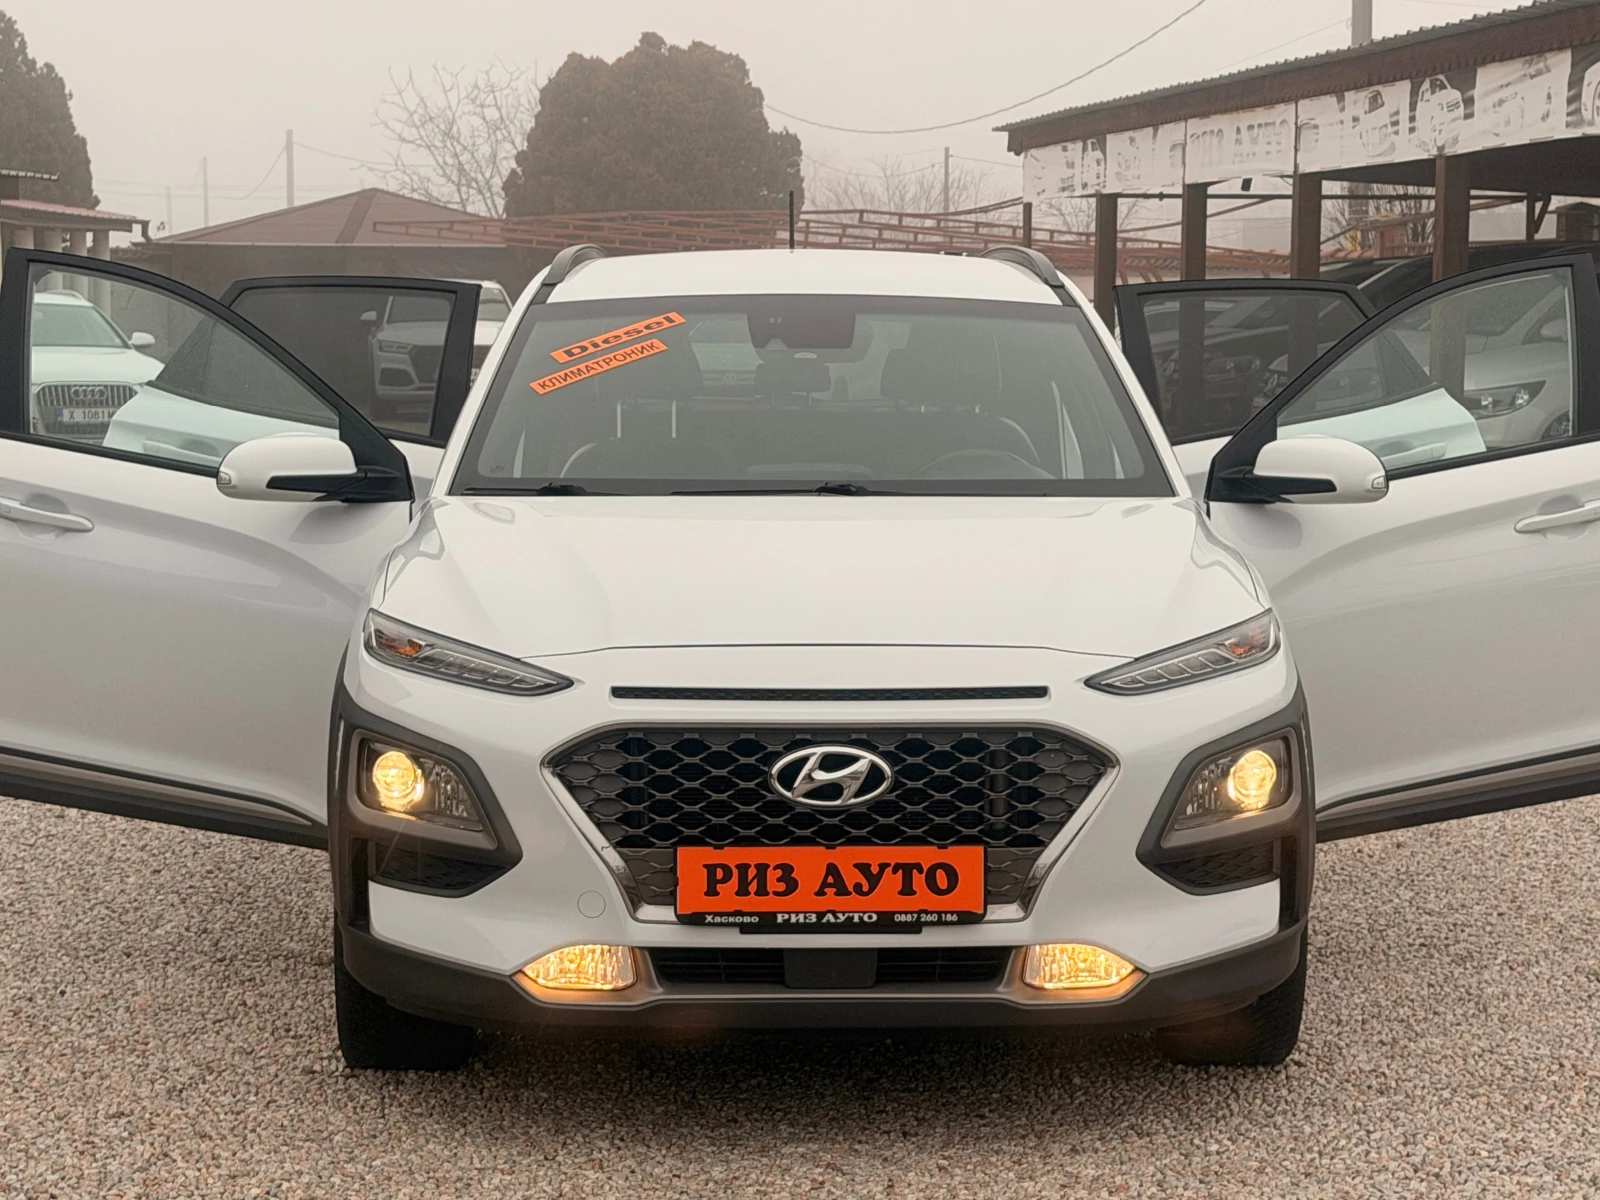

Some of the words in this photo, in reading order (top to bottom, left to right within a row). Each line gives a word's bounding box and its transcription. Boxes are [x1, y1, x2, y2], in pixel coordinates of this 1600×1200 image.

[562, 315, 677, 358] Diesel
[537, 341, 661, 391] КЛИМАТРОНИК
[702, 862, 800, 897] РИЗ
[813, 862, 960, 897] АУТО
[704, 914, 760, 924] Хасково
[776, 912, 818, 924] РИЗ
[821, 912, 878, 923] АУТО
[894, 913, 918, 923] 0887
[920, 913, 939, 922] 260
[940, 912, 959, 922] 186
